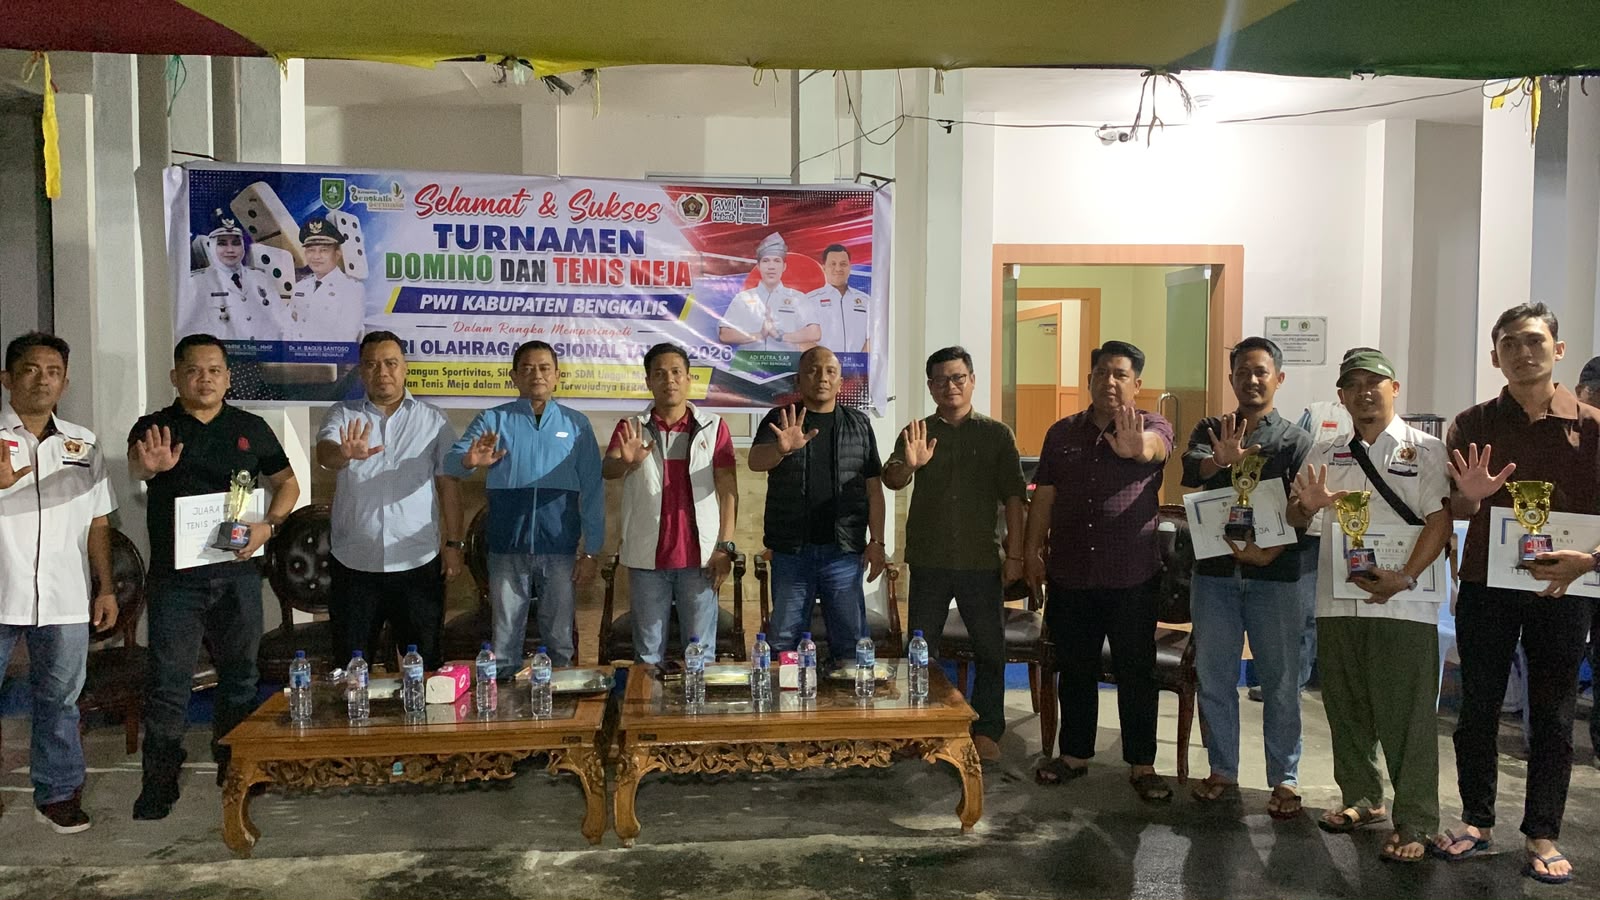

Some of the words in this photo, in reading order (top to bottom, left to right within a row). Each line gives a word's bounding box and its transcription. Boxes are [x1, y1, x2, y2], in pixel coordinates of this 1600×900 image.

[414, 183, 531, 216] Selamat
[538, 191, 557, 216] &
[568, 188, 661, 221] Sukses
[433, 223, 645, 255] TURNAMEN
[385, 252, 493, 282] DOMINO
[500, 258, 546, 283] DAN
[553, 257, 624, 286] TENIS
[630, 259, 692, 287] MEJA
[419, 294, 457, 311] PWI
[462, 295, 568, 314] KABUPATEN
[572, 298, 669, 317] BENGKALIS
[452, 320, 493, 333] Dalam
[498, 322, 546, 338] Rangka
[553, 342, 621, 359] SIONAL
[688, 345, 732, 361] 2026
[442, 367, 494, 378] Sportivitas,
[421, 379, 444, 389] Tenis
[447, 380, 470, 391] Meja
[473, 381, 501, 390] dalam
[192, 505, 220, 516] JUARA
[186, 520, 209, 531] TENIS
